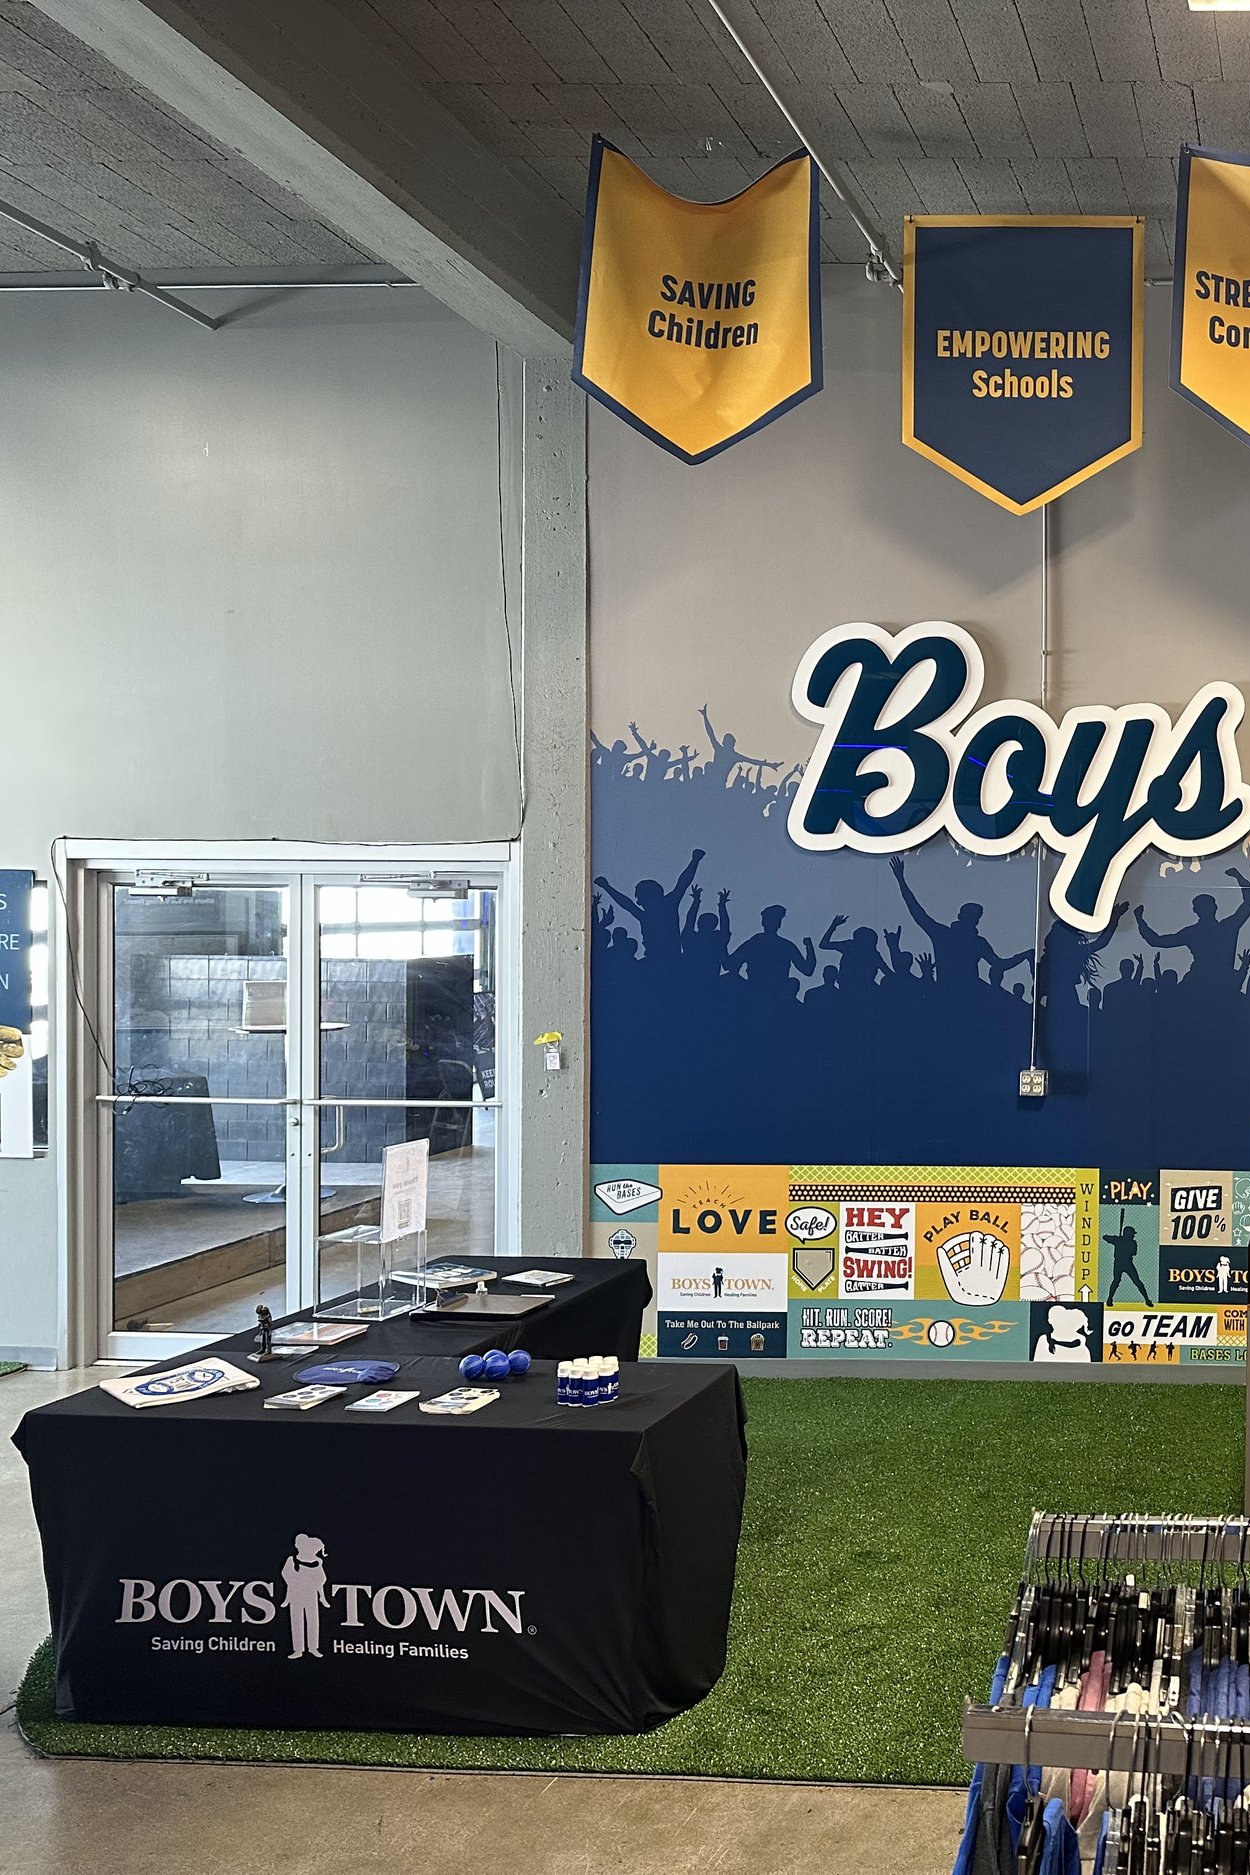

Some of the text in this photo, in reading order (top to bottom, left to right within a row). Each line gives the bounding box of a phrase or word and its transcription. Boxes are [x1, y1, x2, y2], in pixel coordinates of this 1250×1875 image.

[660, 274, 756, 310] SAVING
[647, 310, 759, 349] Children
[937, 330, 1109, 359] EMPOWERING
[973, 369, 1073, 398] Schools
[606, 1183, 621, 1193] RUN
[616, 1186, 642, 1199] BASES
[1110, 1181, 1152, 1200] PLAY
[692, 1198, 726, 1210] TEACH
[1174, 1189, 1221, 1210] GIVE
[673, 1209, 777, 1235] LOVE
[790, 1213, 829, 1235] Safe!
[845, 1208, 910, 1228] HEY
[923, 1209, 1009, 1243] PLAY BALL
[1171, 1214, 1226, 1240] 100%
[845, 1231, 884, 1243] BATTER
[1080, 1183, 1095, 1280] WINDUP
[868, 1246, 907, 1256] BATTER
[843, 1257, 912, 1279] SWING!
[1168, 1269, 1215, 1283] BOYS
[672, 1278, 711, 1290] BOYS
[791, 1275, 836, 1294] HOME PLATE
[845, 1281, 884, 1293] BATTER
[665, 1320, 779, 1330] Take Me Out To The Ballpark
[802, 1308, 892, 1327] HIT. RUN. SCORE!
[1108, 1314, 1214, 1338] GO TEAM
[1223, 1319, 1245, 1331] WITH
[801, 1329, 893, 1348] REPEAT.
[1190, 1348, 1230, 1362] BASES
[115, 1578, 276, 1625] BOYS
[151, 1637, 275, 1653] Saving Children
[333, 1640, 469, 1659] Healing Families
